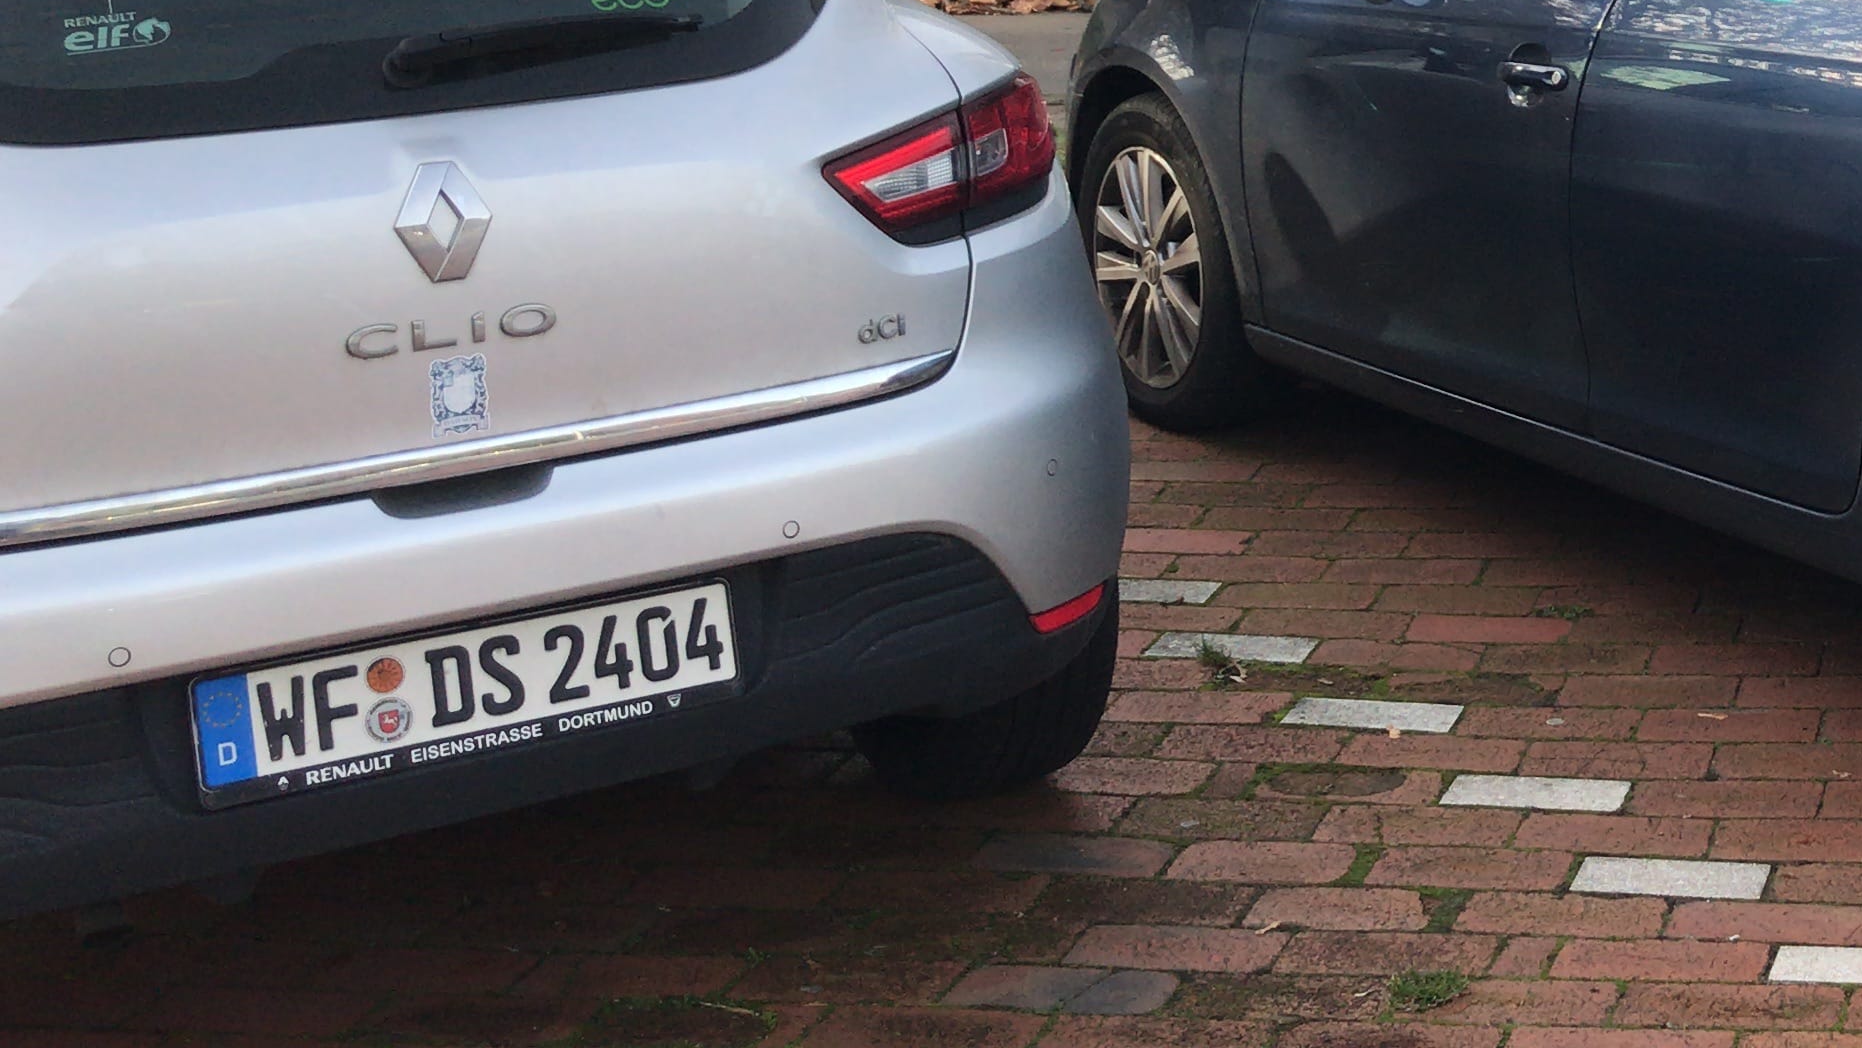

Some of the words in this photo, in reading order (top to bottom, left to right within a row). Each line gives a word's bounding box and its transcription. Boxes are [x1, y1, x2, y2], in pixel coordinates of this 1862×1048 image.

[63, 11, 137, 28] RENAULT
[63, 23, 130, 51] elf
[345, 303, 557, 361] CLIO
[218, 741, 238, 766] D
[256, 664, 360, 762] WF
[424, 634, 526, 728] DS
[543, 597, 724, 705] 2404
[305, 753, 395, 786] RENAULT
[410, 723, 543, 764] EISENSTRASSE
[558, 700, 653, 733] DORTMUND
